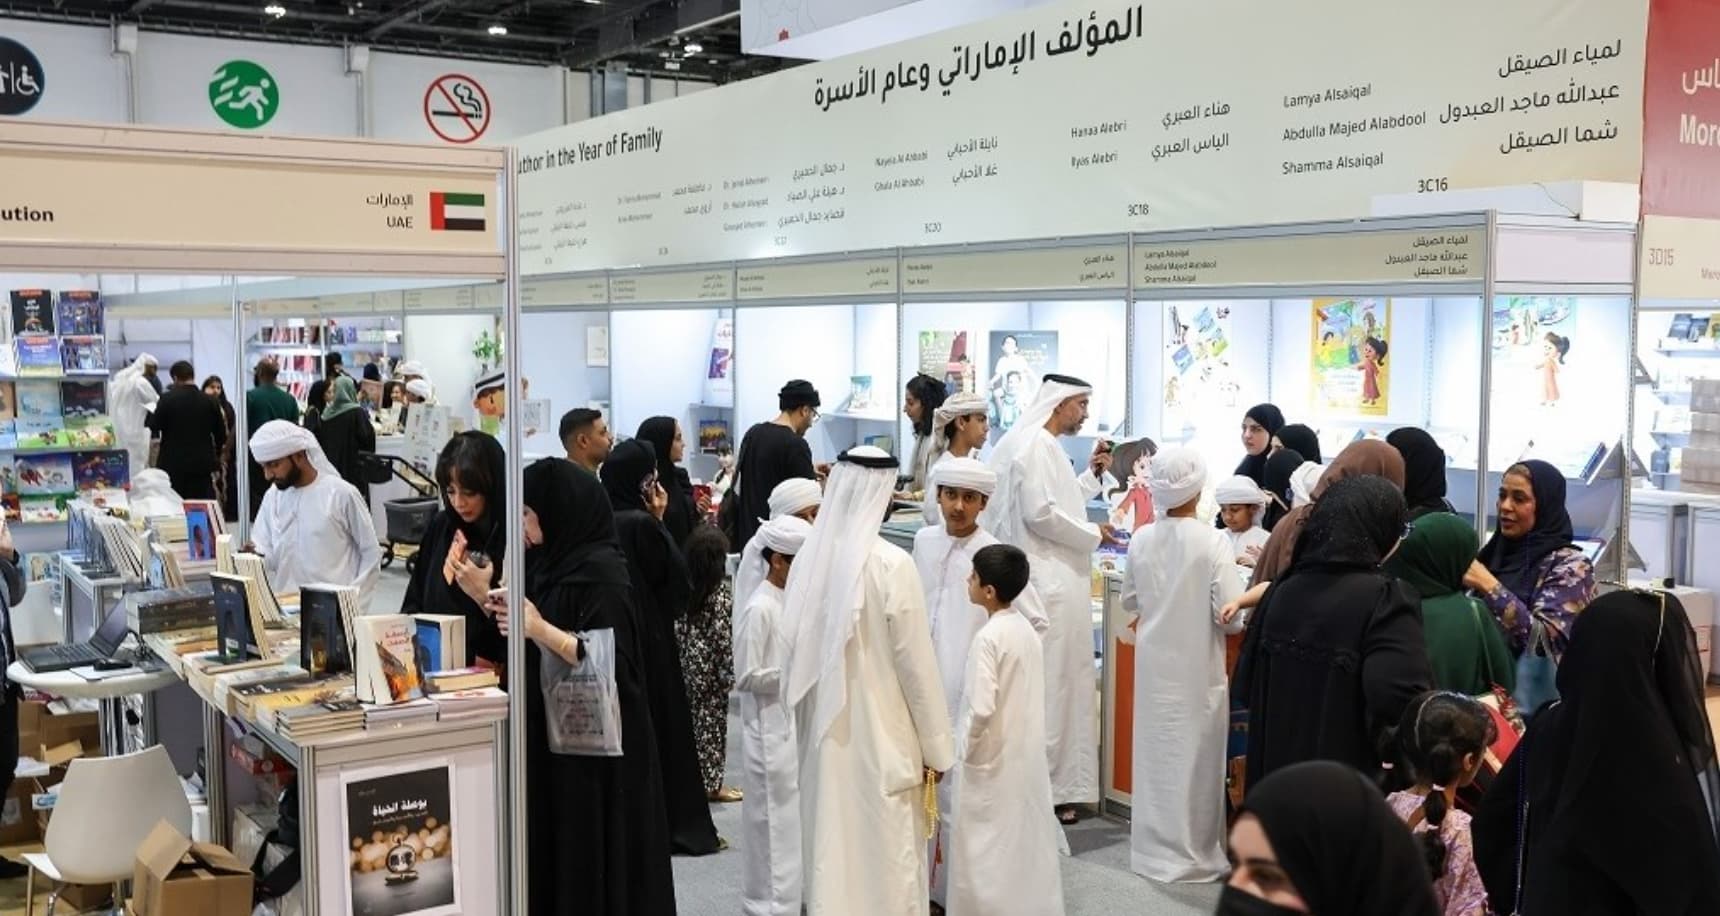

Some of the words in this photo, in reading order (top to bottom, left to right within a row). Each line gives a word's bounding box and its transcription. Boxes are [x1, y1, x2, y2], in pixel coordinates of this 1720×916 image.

[1045, 4, 1143, 58] المؤلف
[938, 30, 1035, 97] الإماراتي
[1498, 48, 1567, 78] الصيقل
[1573, 39, 1622, 66] لمياء
[814, 66, 876, 112] الأسرة
[881, 62, 930, 104] وعام
[1283, 93, 1321, 108] Lamya
[1324, 83, 1372, 102] Alsaiqal
[1556, 77, 1620, 105] عبدالله
[1204, 101, 1231, 118] هناء
[1439, 96, 1504, 124] العبدول
[1509, 92, 1550, 114] ماجد
[1071, 125, 1098, 139] Hanaa
[1100, 120, 1127, 134] Alebri
[1162, 105, 1200, 130] العبري
[1282, 126, 1326, 141] Abdulla
[1329, 119, 1367, 137] Majed
[1369, 111, 1426, 130] Alabdool
[1680, 114, 1720, 146] Mor
[1193, 133, 1229, 154] الياس
[1500, 127, 1568, 154] الصيقل
[1575, 119, 1618, 143] شما
[546, 150, 555, 168] in
[558, 147, 575, 166] the
[578, 141, 602, 162] Year
[606, 134, 617, 157] of
[621, 126, 663, 153] Family
[1151, 138, 1190, 162] العبري
[1282, 159, 1333, 175] Shamma
[1336, 152, 1384, 168] Alsaiqal
[1417, 178, 1449, 195] 3C16
[366, 192, 414, 210] الإمارات
[1128, 203, 1149, 217] 3C18
[1, 205, 54, 223] ution
[386, 215, 413, 229] UAE
